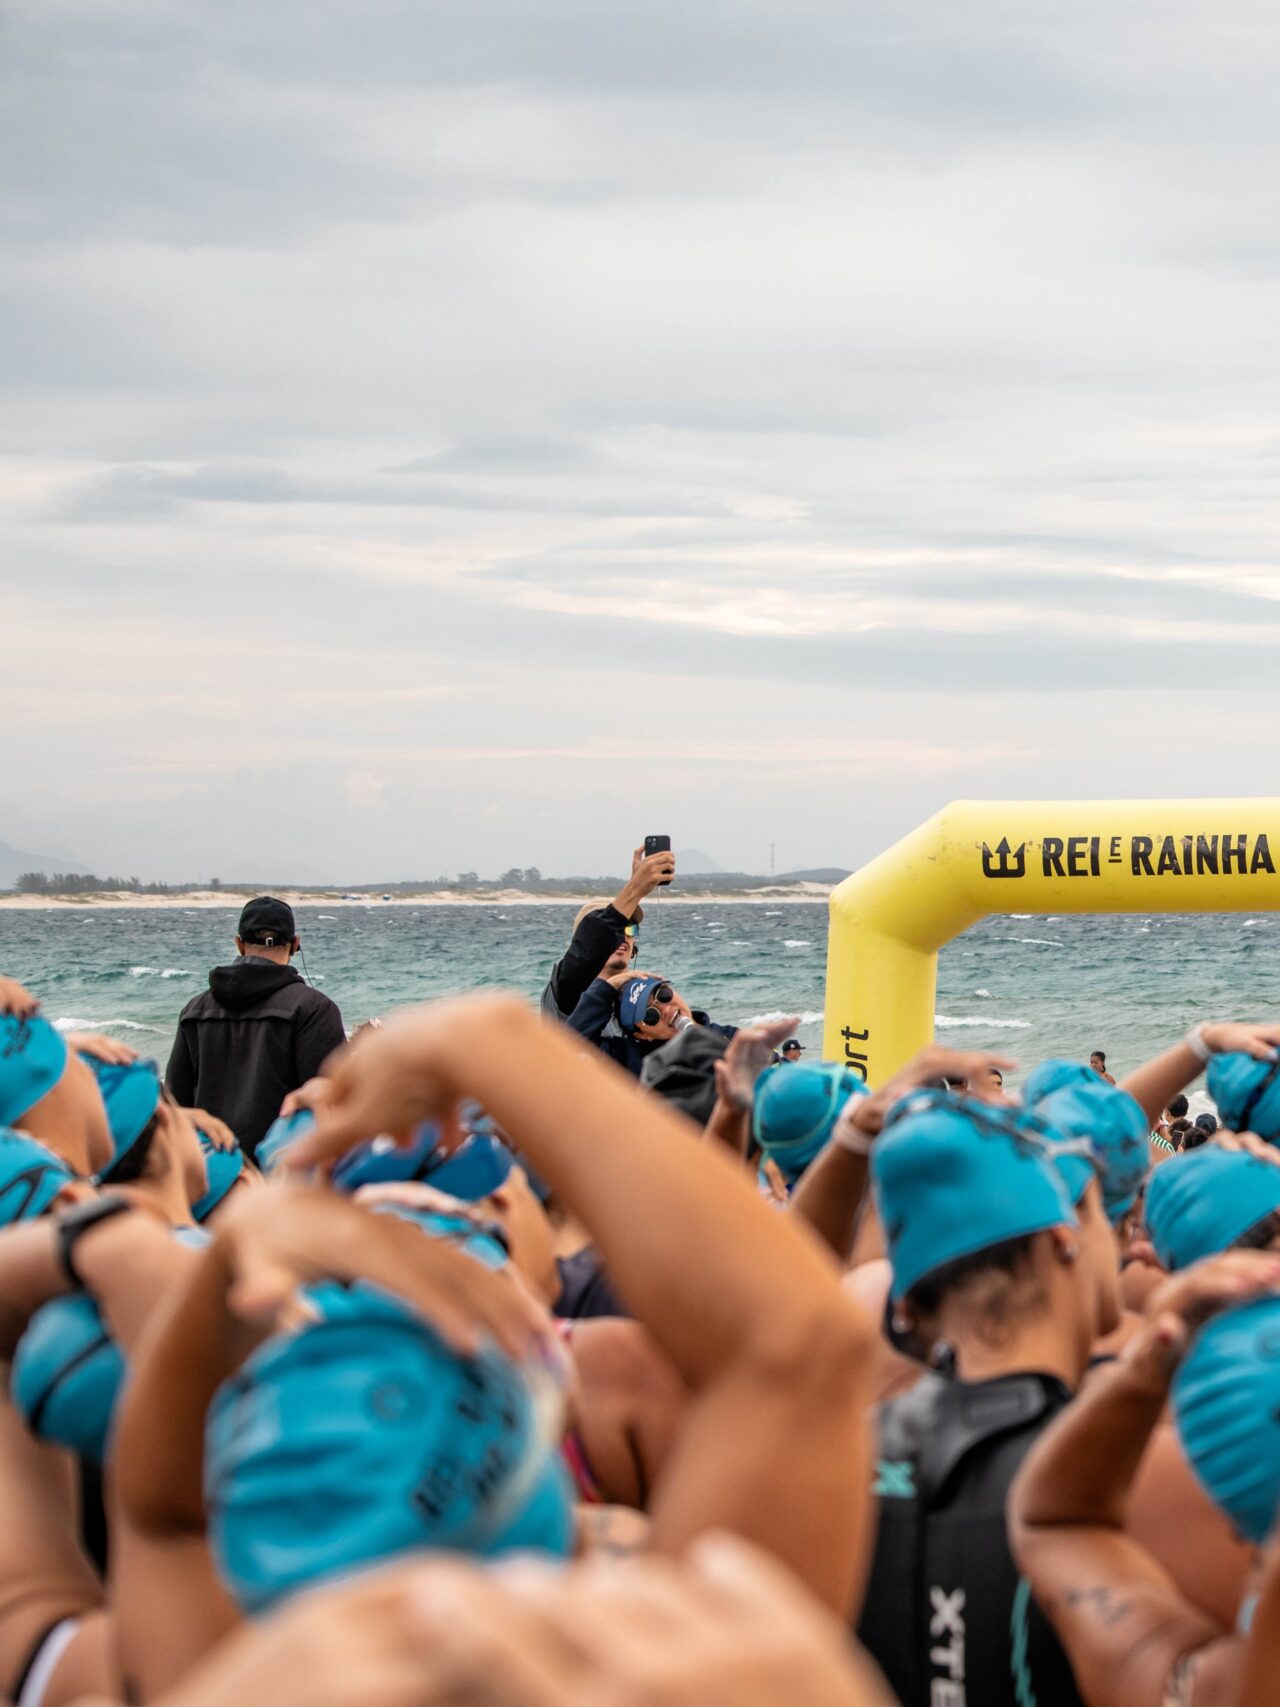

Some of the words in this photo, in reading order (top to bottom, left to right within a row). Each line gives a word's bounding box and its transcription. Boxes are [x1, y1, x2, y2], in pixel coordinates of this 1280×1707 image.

[1042, 836, 1100, 877] REI
[1108, 836, 1122, 863] E
[1131, 834, 1277, 876] RAINHA
